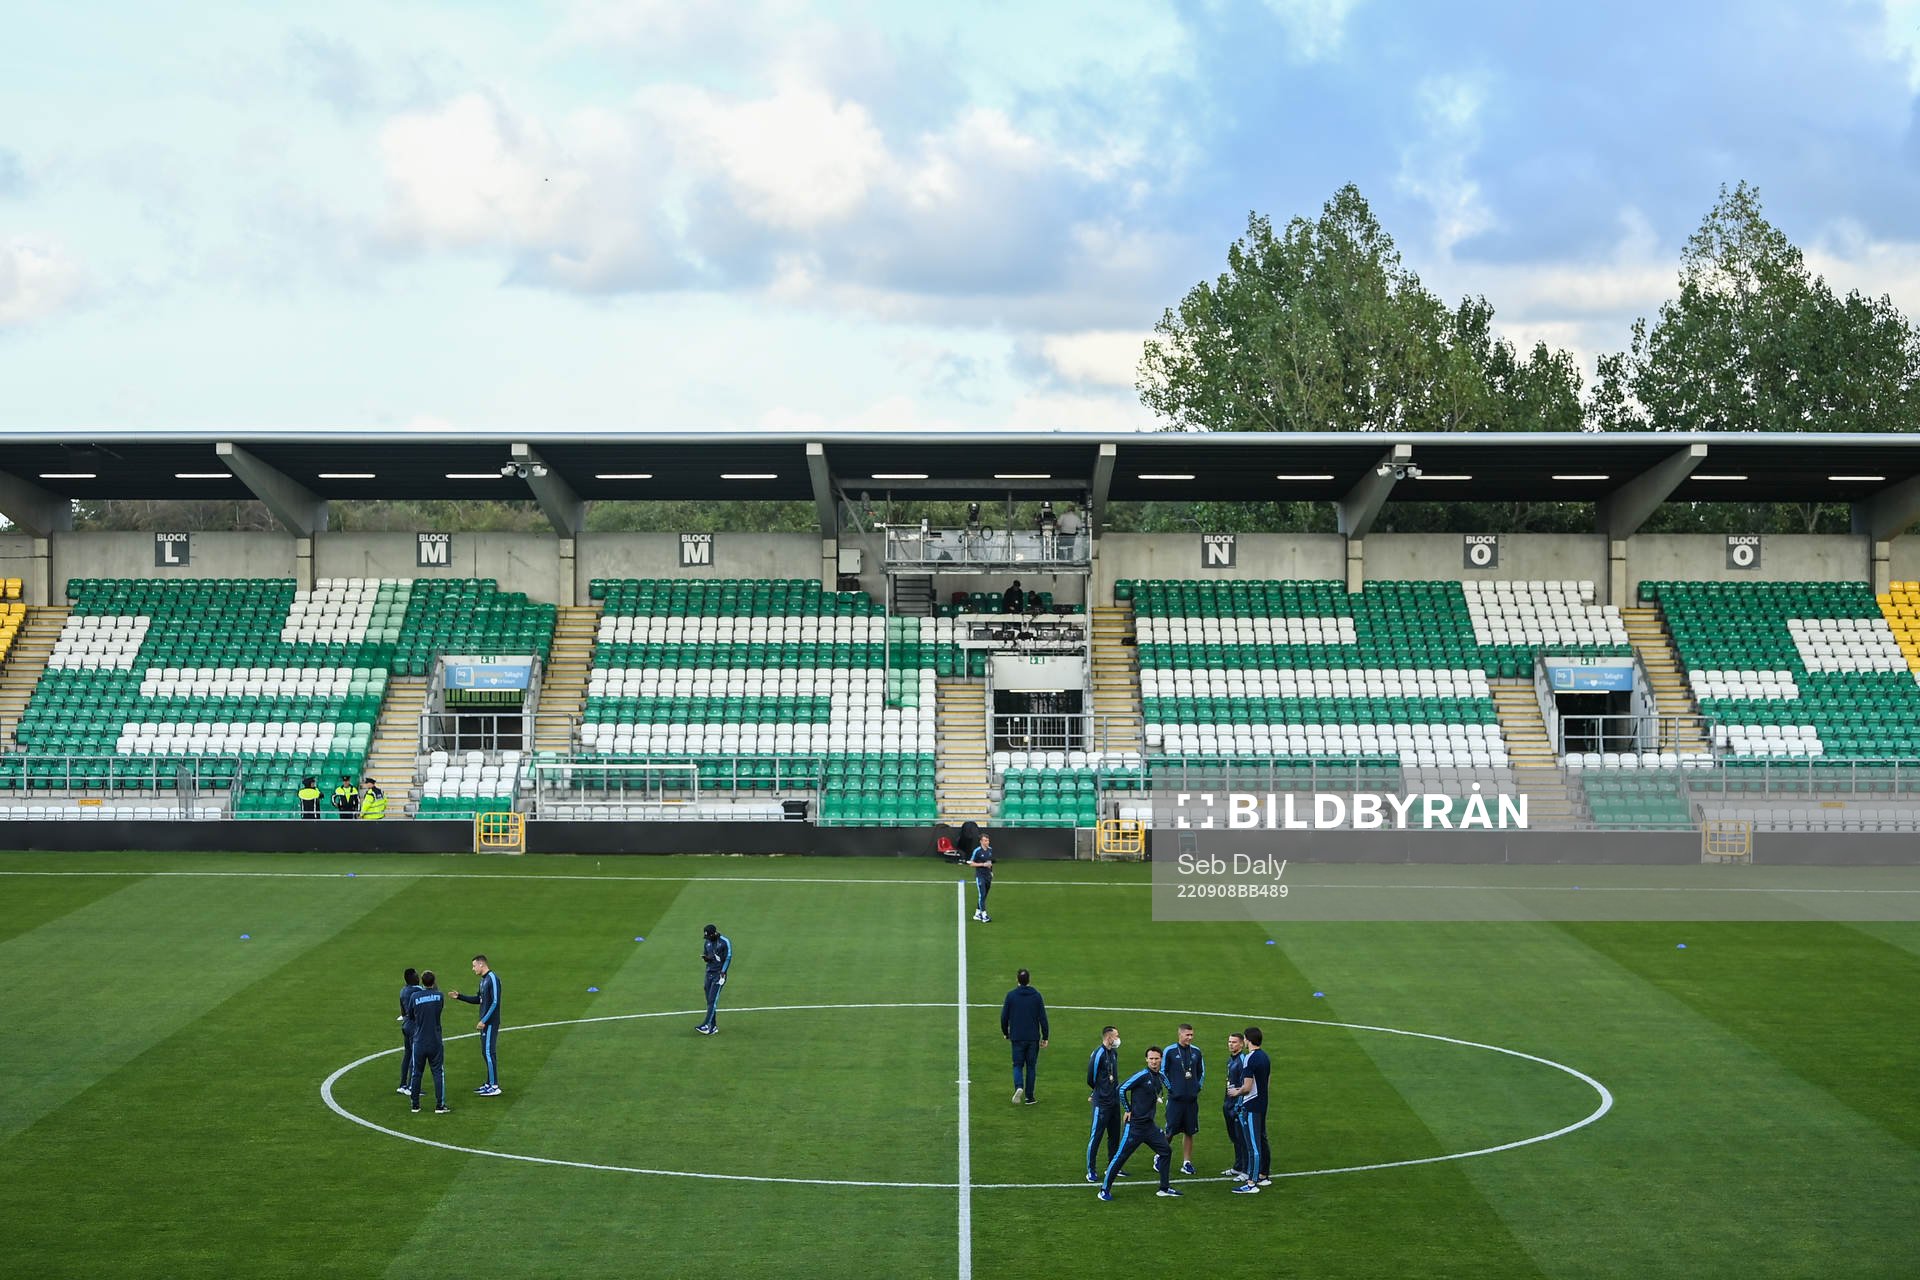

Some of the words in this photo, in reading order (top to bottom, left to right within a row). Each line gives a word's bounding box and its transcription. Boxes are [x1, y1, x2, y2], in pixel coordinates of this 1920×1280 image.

[157, 533, 187, 542] BLOCK
[419, 533, 449, 542] BLOCK
[681, 534, 711, 543] BLOCK
[1204, 535, 1234, 544] BLOCK
[1465, 535, 1496, 544] BLOCK
[1728, 536, 1759, 545] BLOCK
[165, 541, 179, 563] L
[421, 542, 446, 563] M
[683, 542, 709, 564] M
[1208, 543, 1229, 565] N
[1470, 544, 1492, 565] O
[1733, 544, 1754, 566] O
